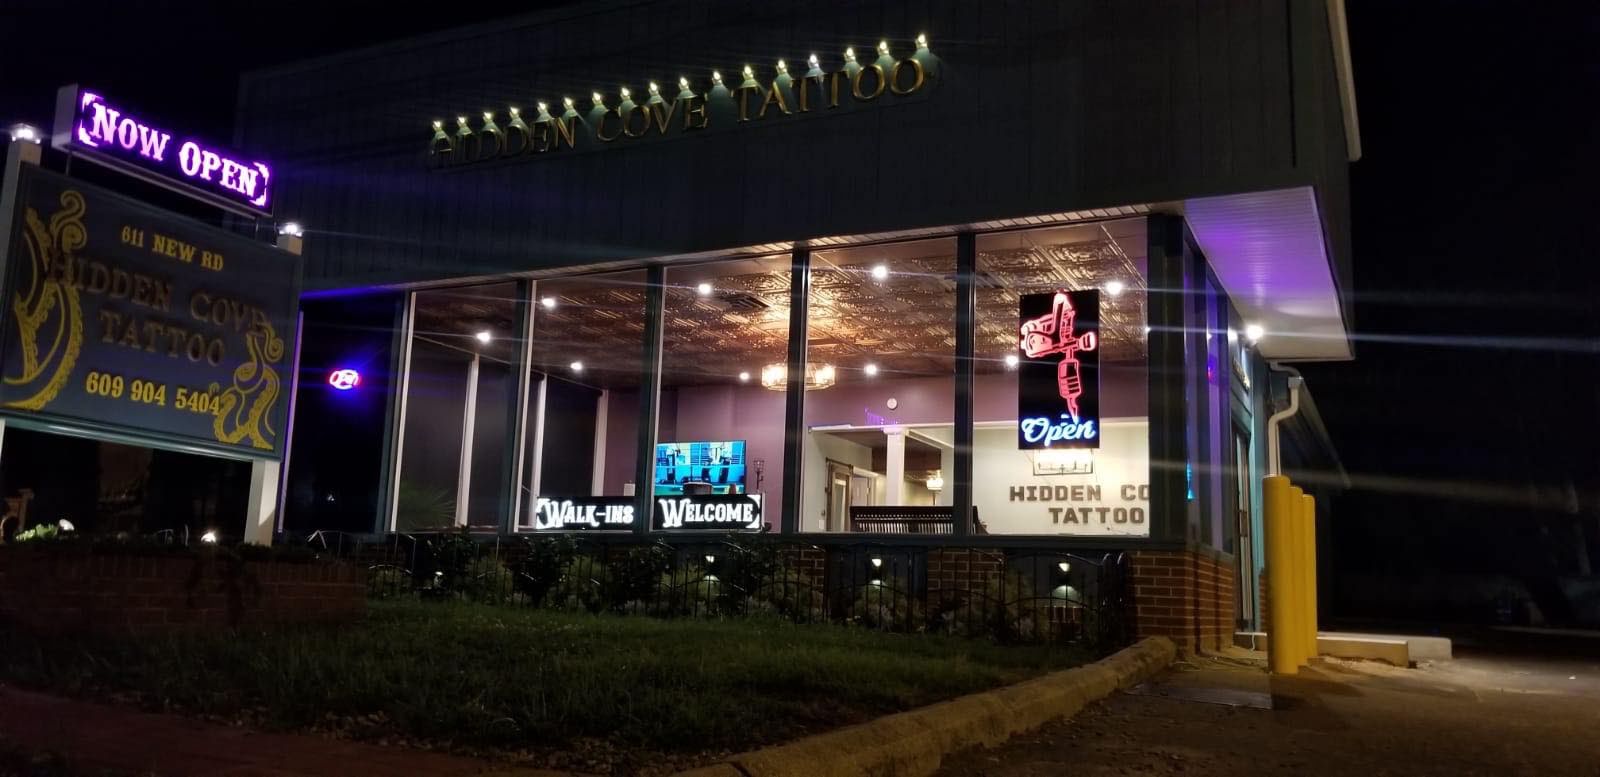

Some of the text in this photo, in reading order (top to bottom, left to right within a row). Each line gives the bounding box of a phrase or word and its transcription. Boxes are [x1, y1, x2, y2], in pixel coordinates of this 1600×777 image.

[431, 58, 925, 168] HIDDEN COVE TATTOO
[91, 103, 260, 198] NOW OPEN
[121, 225, 224, 271] 611 NEW RD
[51, 252, 267, 335] HIDDEN COVE
[98, 310, 225, 366] TATTOO
[86, 372, 222, 416] 609 904 5404
[1021, 417, 1097, 447] Open
[541, 498, 753, 529] WALK-INS WELCOME
[1009, 484, 1150, 502] HIDDEN CO
[1049, 507, 1144, 524] TATTOO
